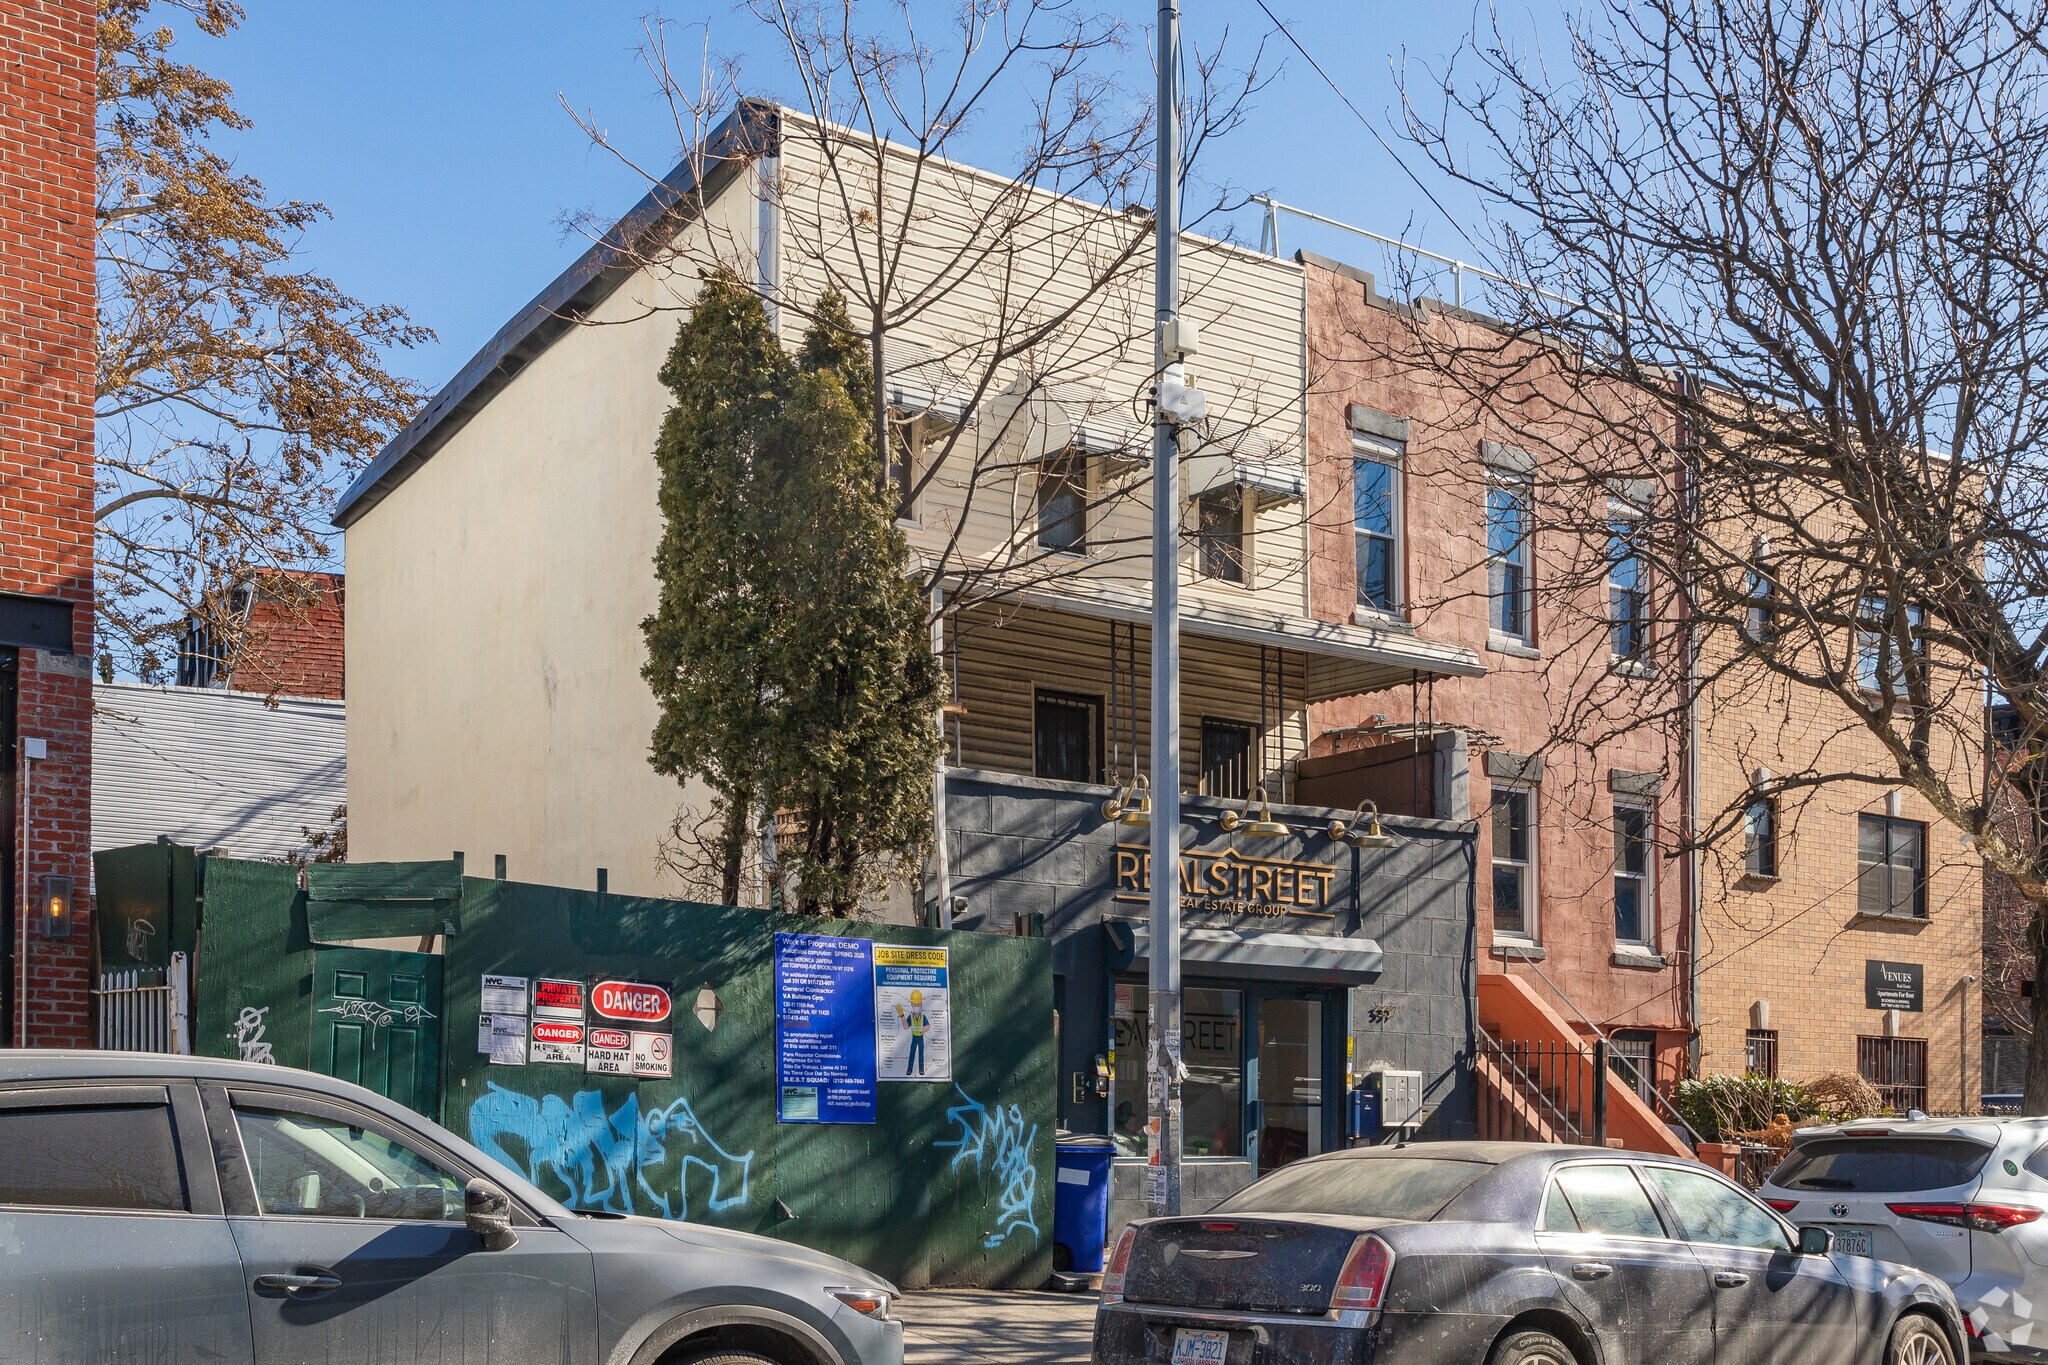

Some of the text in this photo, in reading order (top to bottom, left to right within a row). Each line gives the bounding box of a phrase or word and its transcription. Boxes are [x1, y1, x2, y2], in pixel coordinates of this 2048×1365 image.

[1180, 896, 1288, 916] EAL ESTATE GROUP
[783, 938, 799, 946] Work
[808, 940, 837, 949] Progress:
[838, 942, 860, 950] DEMO
[877, 950, 944, 961] JOB SITE DRESS CODE
[910, 967, 937, 975] PROTECTIVE
[485, 977, 503, 985] NYC
[886, 973, 937, 982] EQUIPMENT REQUIRED
[541, 982, 578, 995] PRIVATE
[782, 985, 835, 994] General Contractor:
[536, 991, 582, 1004] PROPERTY
[603, 989, 660, 1014] DANGER
[811, 994, 825, 1002] Corp.
[546, 1001, 582, 1009] TRESPASSING
[481, 1015, 492, 1023] NY
[537, 1027, 580, 1039] DANGER
[593, 1033, 627, 1046] DANGER
[546, 1053, 571, 1062] AREA
[588, 1050, 630, 1062] HARD HAT
[635, 1053, 646, 1062] NO
[597, 1062, 620, 1072] AREA
[634, 1061, 668, 1072] SMOKING
[784, 1087, 798, 1095] NYC
[1299, 1283, 1322, 1292] 300
[1175, 1338, 1223, 1360] KJM-3821
